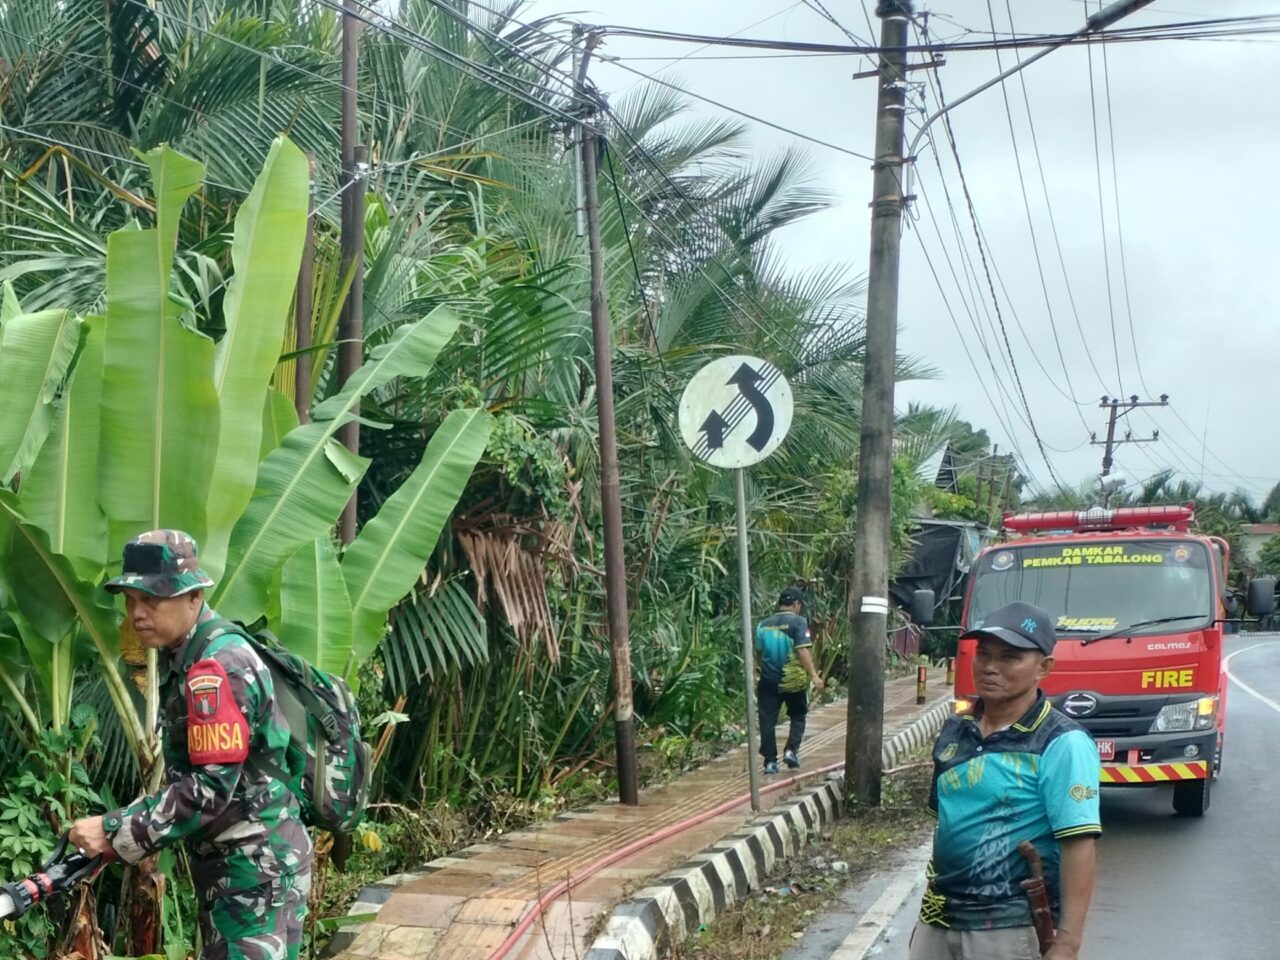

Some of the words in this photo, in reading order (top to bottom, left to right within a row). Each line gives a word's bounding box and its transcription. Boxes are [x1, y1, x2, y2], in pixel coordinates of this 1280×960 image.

[1062, 546, 1123, 557] DAMKAR
[1023, 556, 1082, 568] PEMKAB
[1085, 554, 1163, 564] TABALONG
[1141, 669, 1194, 689] FIRE
[1097, 741, 1112, 754] HK
